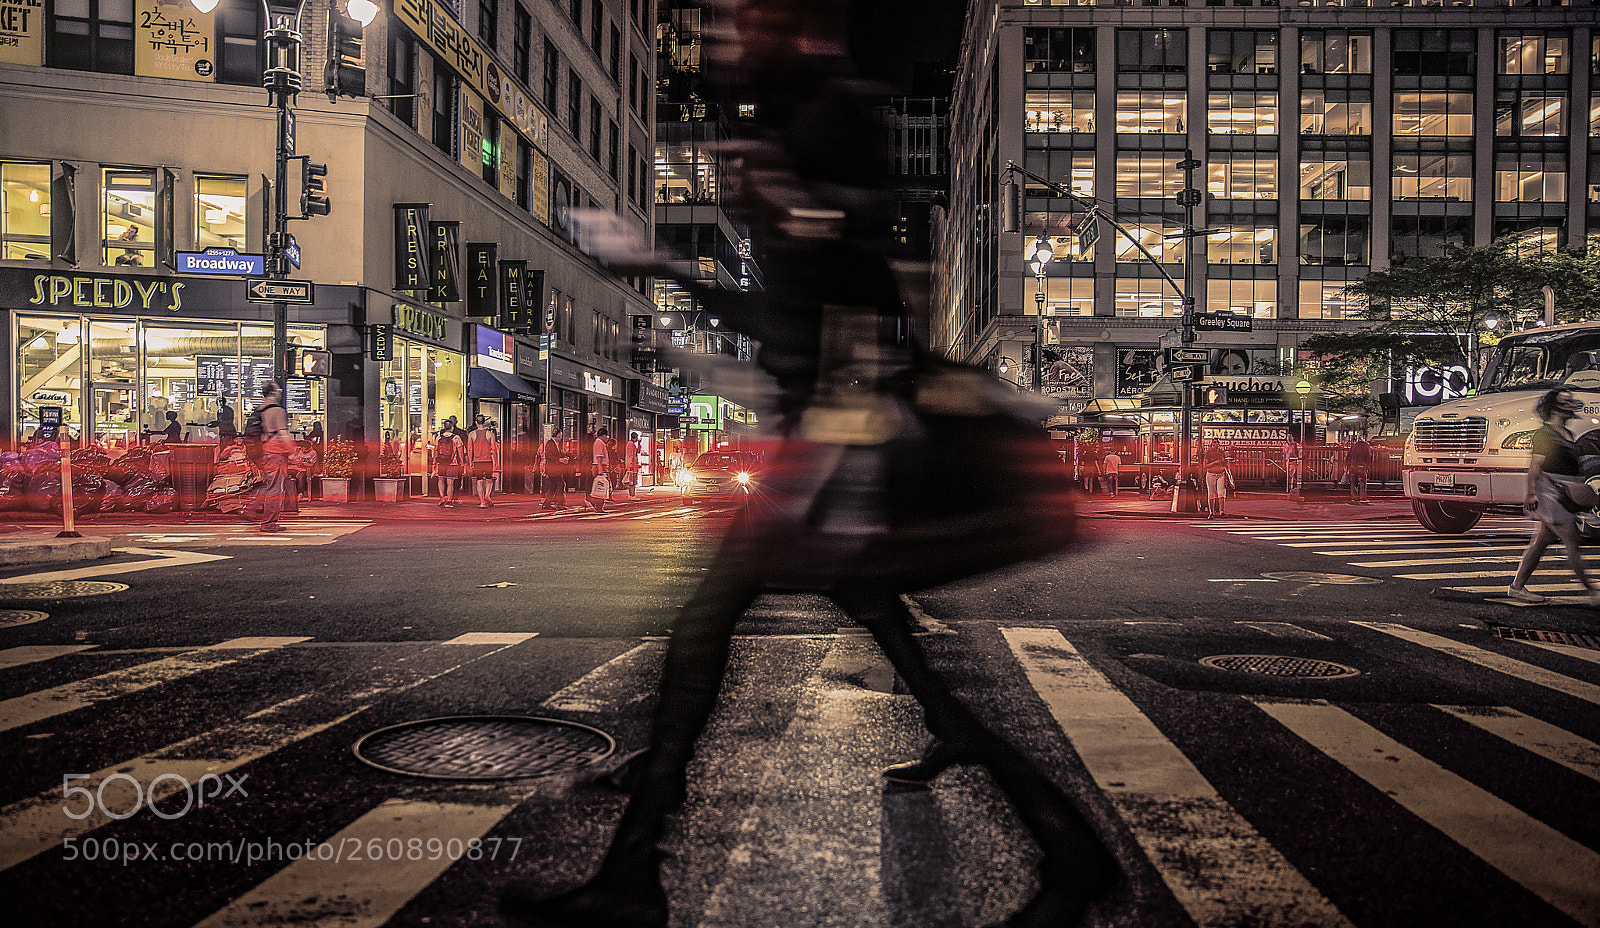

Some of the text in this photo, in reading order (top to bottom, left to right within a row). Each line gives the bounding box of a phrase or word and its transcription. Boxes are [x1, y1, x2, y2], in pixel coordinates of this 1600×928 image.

[140, 6, 200, 37] 2층버스
[148, 32, 208, 55] 뉴욕투어
[186, 256, 255, 273] Broadway
[407, 208, 418, 286] FRESH
[437, 226, 447, 298] DRINK
[29, 274, 186, 312] SPEEDY'S
[258, 286, 301, 295] ONE WAY
[477, 251, 488, 299] EAT
[508, 267, 518, 322] MEET
[526, 271, 534, 335] NATURAL
[1199, 316, 1250, 329] Greeley Square
[376, 324, 386, 360] SPEEDY'S
[1203, 428, 1287, 440] EMPANADAS
